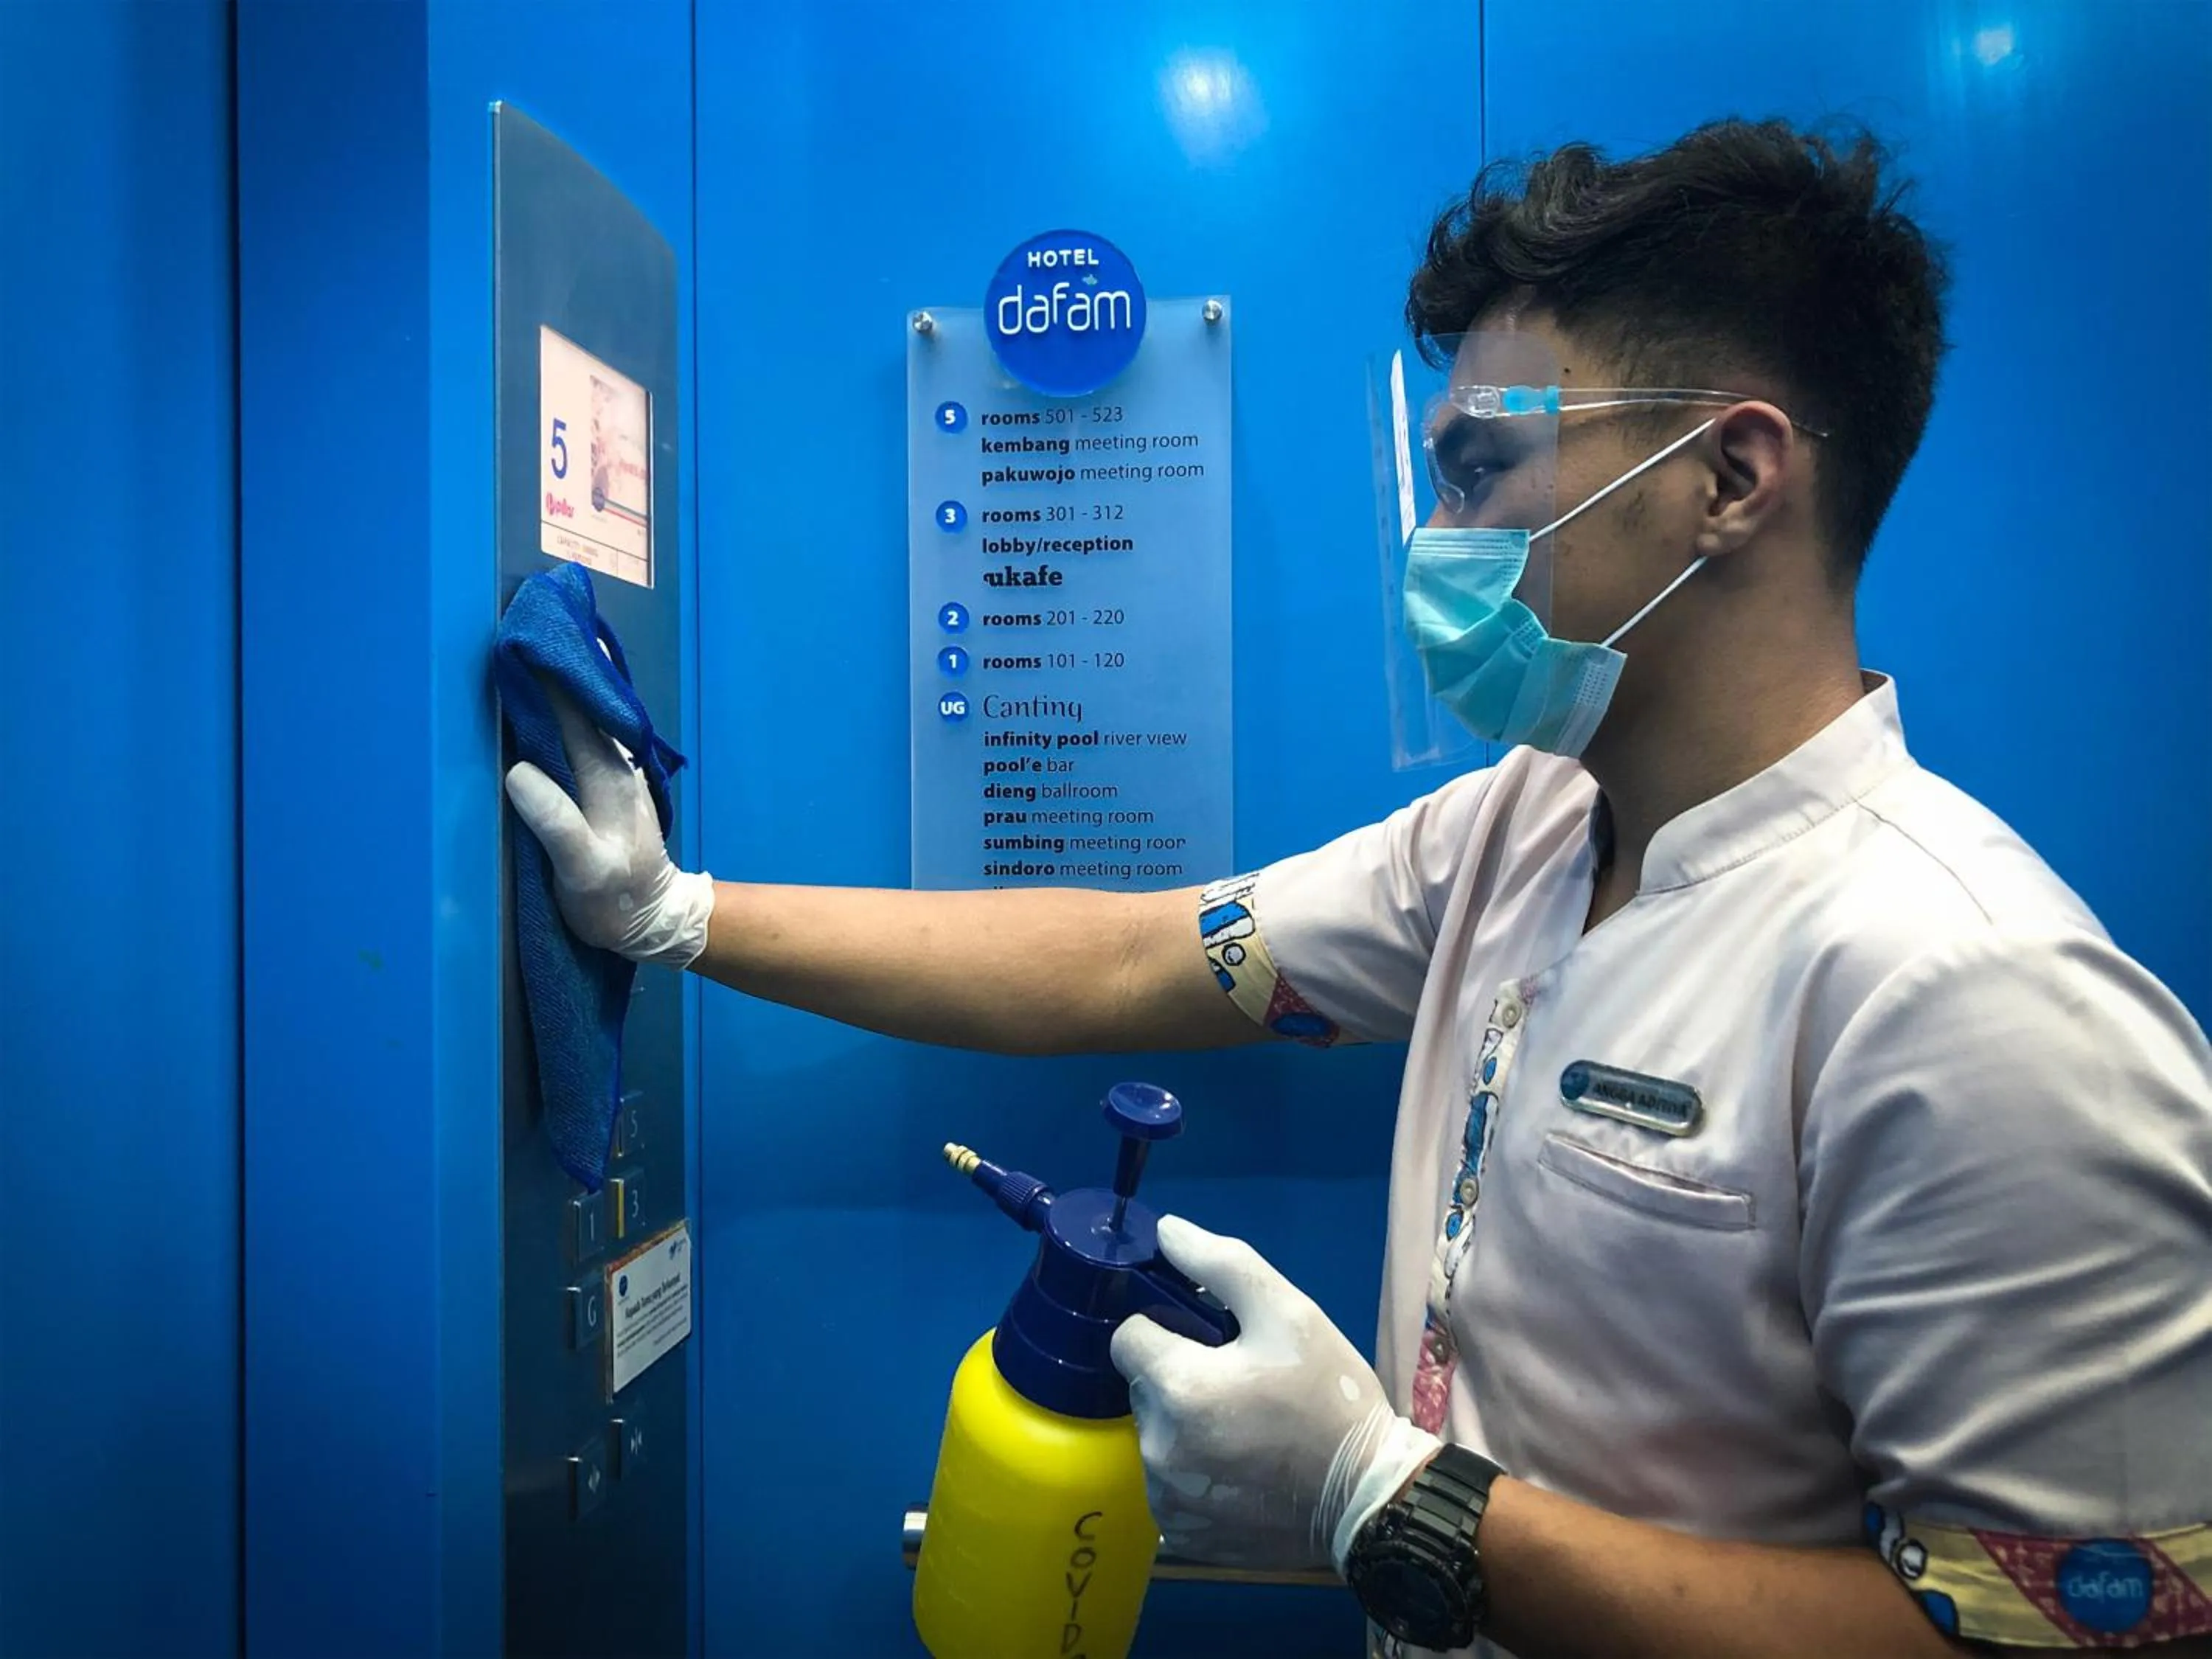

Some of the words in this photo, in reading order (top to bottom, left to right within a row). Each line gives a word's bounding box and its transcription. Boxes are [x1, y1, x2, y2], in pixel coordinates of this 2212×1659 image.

[1028, 248, 1099, 267] HOTEL
[998, 282, 1130, 335] dafam
[945, 410, 956, 424] 5
[981, 412, 1040, 425] rooms
[1046, 408, 1074, 424] 501
[1092, 406, 1122, 422] 523
[552, 417, 568, 479] 5
[981, 437, 1069, 455] kembang
[1075, 434, 1146, 453] meeting
[1152, 435, 1198, 448] room
[982, 465, 1075, 486] pakuwojo
[1080, 463, 1152, 482] meeting
[1158, 465, 1204, 478] room
[945, 509, 956, 523] 3
[982, 509, 1040, 523] rooms
[1046, 507, 1075, 521] 301
[1093, 505, 1123, 520] 312
[982, 535, 1133, 556] lobby/reception
[983, 564, 1062, 587] ukafe
[947, 611, 958, 625] 2
[983, 613, 1041, 626] rooms
[1046, 611, 1075, 625] 201
[1093, 610, 1124, 625] 220
[949, 654, 956, 668] 1
[984, 657, 1041, 669] rooms
[1048, 653, 1075, 668] 101
[1095, 653, 1124, 667] 120
[941, 701, 965, 714] UG
[984, 695, 1082, 723] Canting
[984, 731, 1051, 750] infinity
[1057, 731, 1099, 749] pool
[1104, 731, 1141, 745] river
[1147, 732, 1186, 745] view
[1047, 757, 1074, 772] bar
[984, 783, 1036, 802] dieng
[1042, 782, 1117, 799] ballroom
[984, 812, 1026, 827] prau
[1032, 810, 1102, 827] meeting
[1108, 812, 1153, 823] room
[984, 835, 1064, 853] sumbing
[1069, 836, 1140, 854] meeting
[984, 860, 1054, 875] sindoro
[1060, 861, 1130, 880] meeting
[1136, 863, 1182, 875] room
[1061, 1511, 1103, 1655] COVID
[2067, 1571, 2143, 1603] dafam
